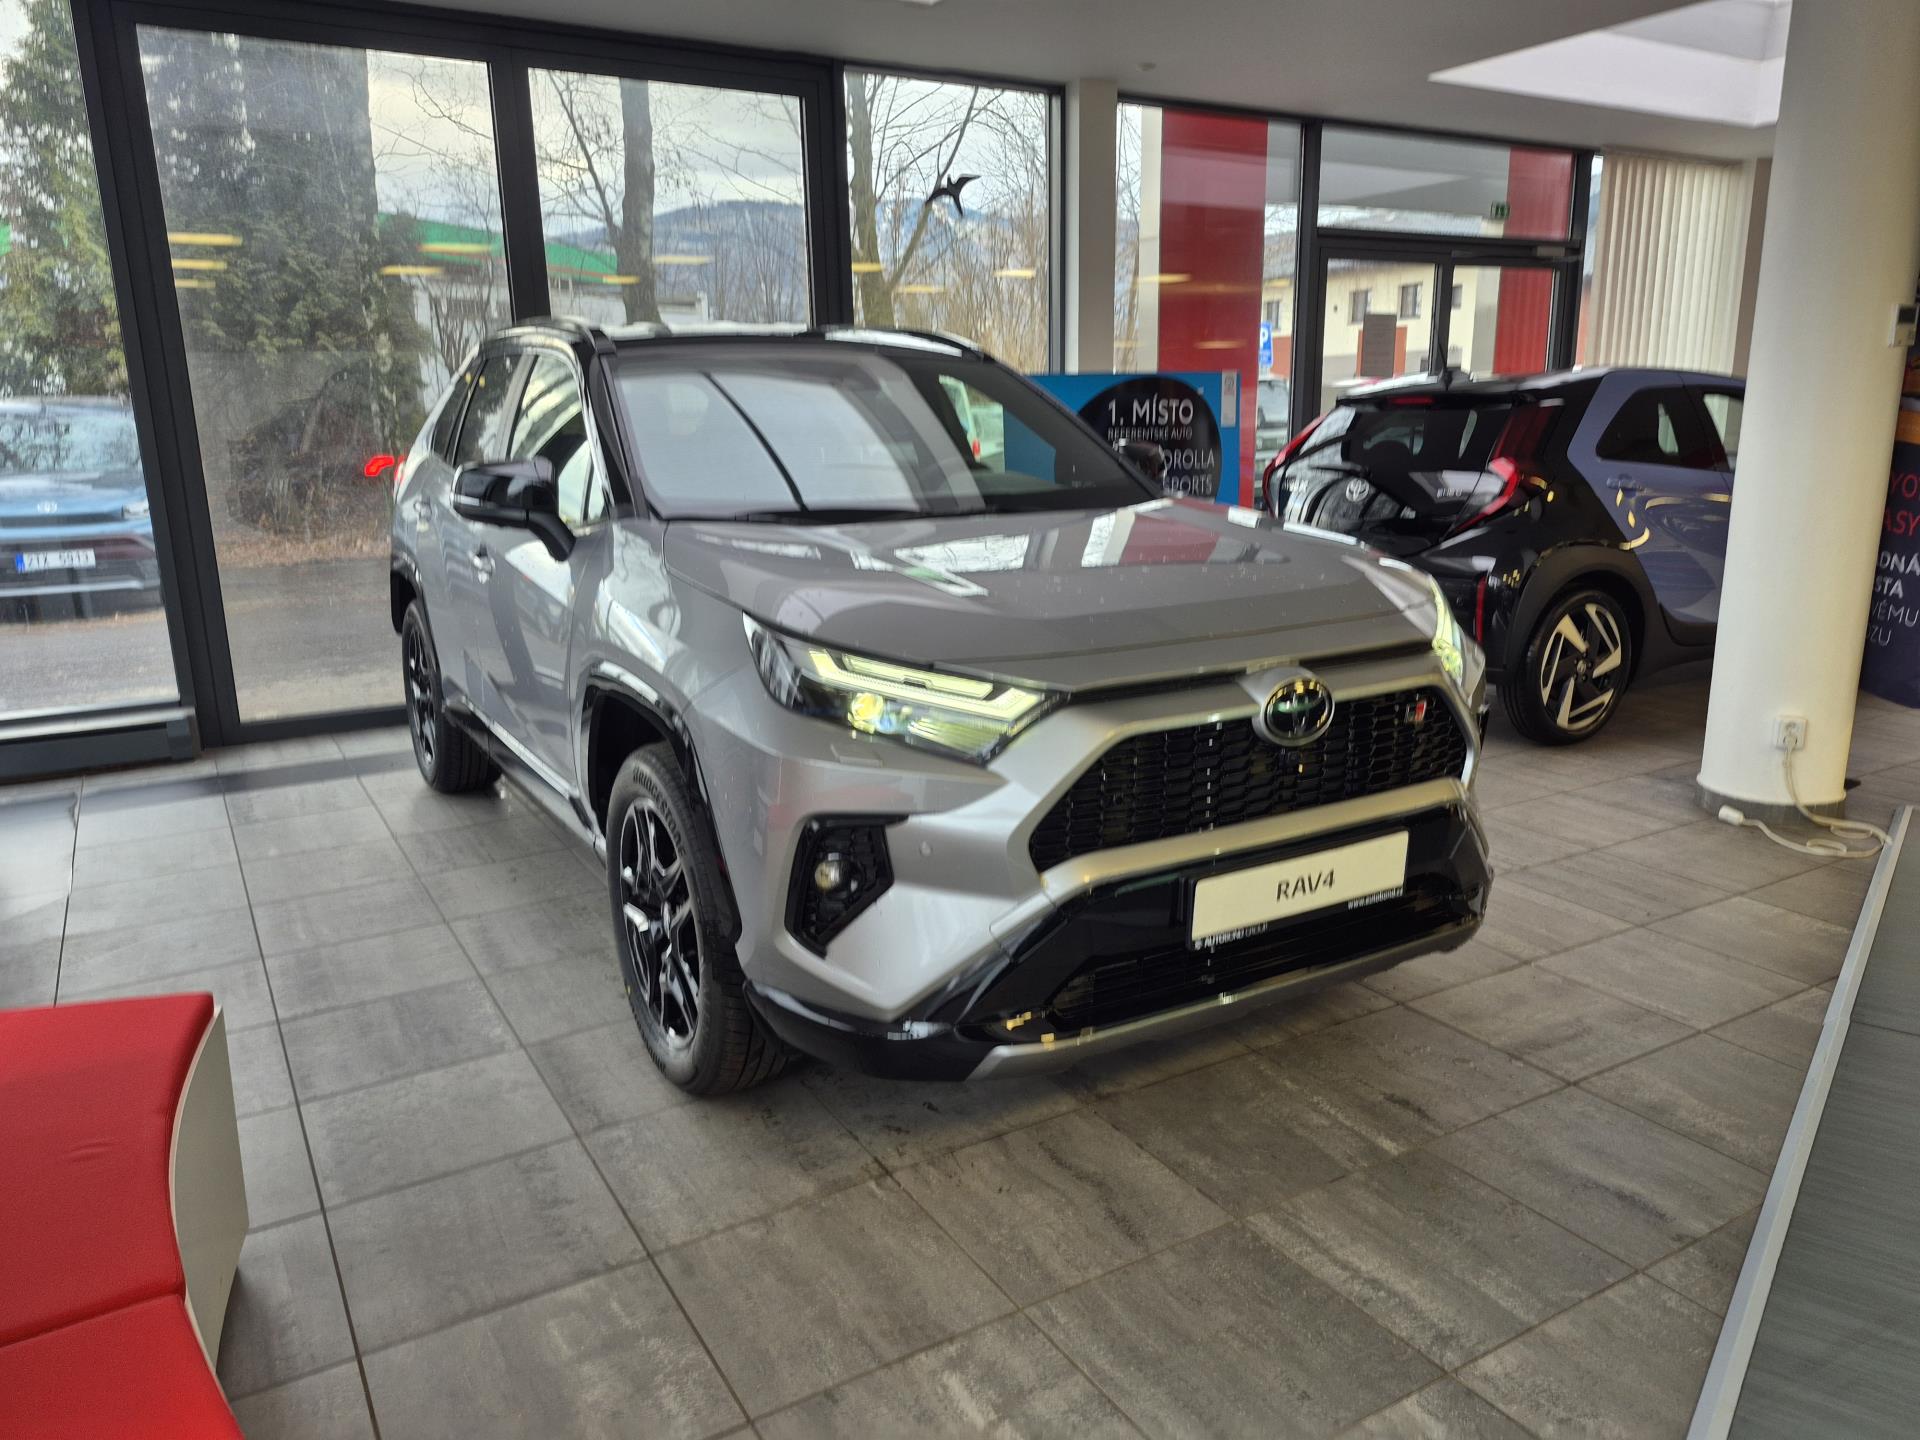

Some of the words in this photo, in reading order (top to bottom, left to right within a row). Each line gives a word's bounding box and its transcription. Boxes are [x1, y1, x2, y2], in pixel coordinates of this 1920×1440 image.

[1108, 399, 1124, 426] 1.
[1132, 392, 1194, 426] MÍSTO
[1163, 447, 1215, 471] OROLLA
[1276, 868, 1336, 904] RAV4
